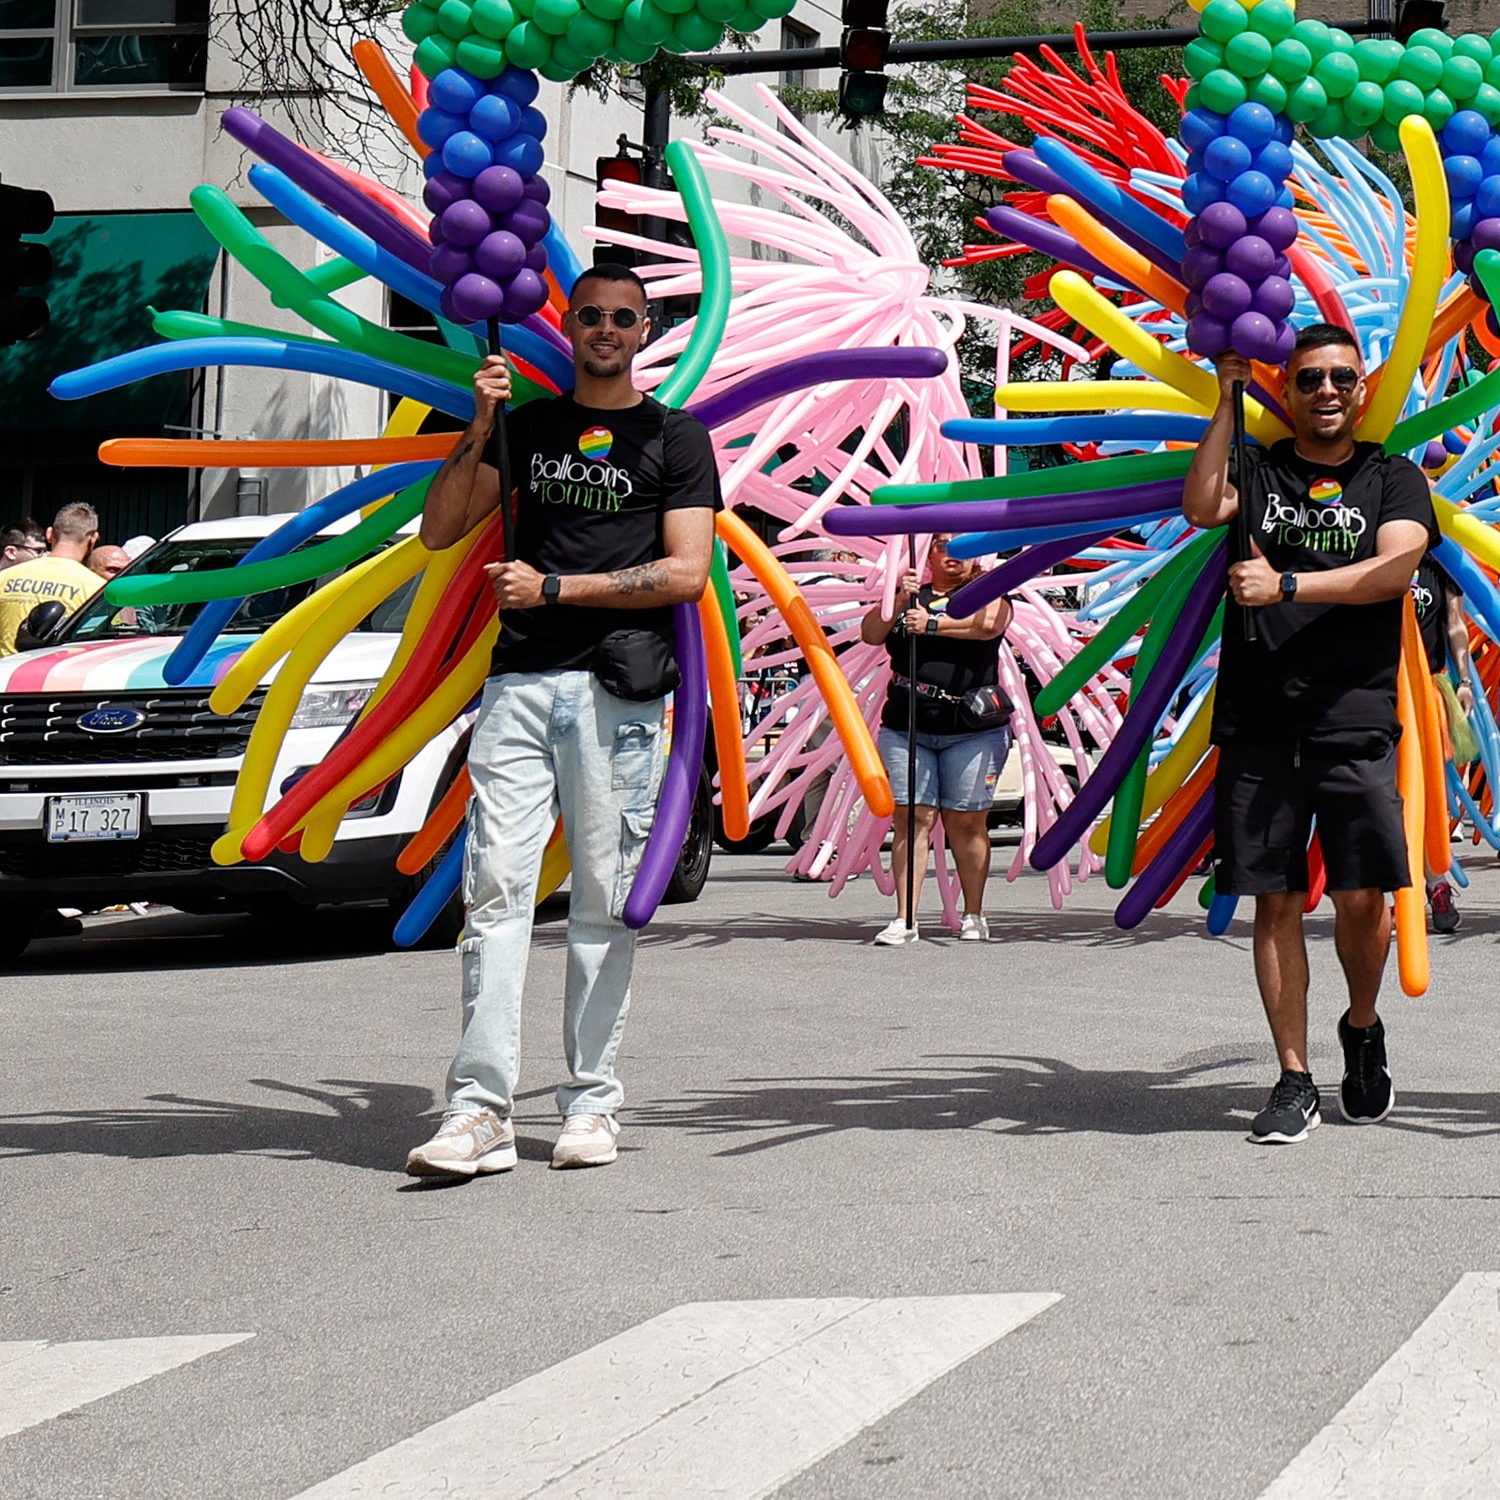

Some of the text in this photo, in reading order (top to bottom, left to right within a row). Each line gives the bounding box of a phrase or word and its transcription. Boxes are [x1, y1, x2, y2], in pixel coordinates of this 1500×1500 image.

[529, 480, 541, 493] by
[531, 452, 633, 498] Balloons
[1264, 493, 1366, 537] Balloons
[1261, 520, 1360, 560] by Tommy
[4, 578, 80, 600] SECURITY
[89, 710, 128, 726] Ford
[75, 796, 115, 806] ILLINOIS
[69, 810, 89, 832] 17
[100, 808, 131, 831] 327
